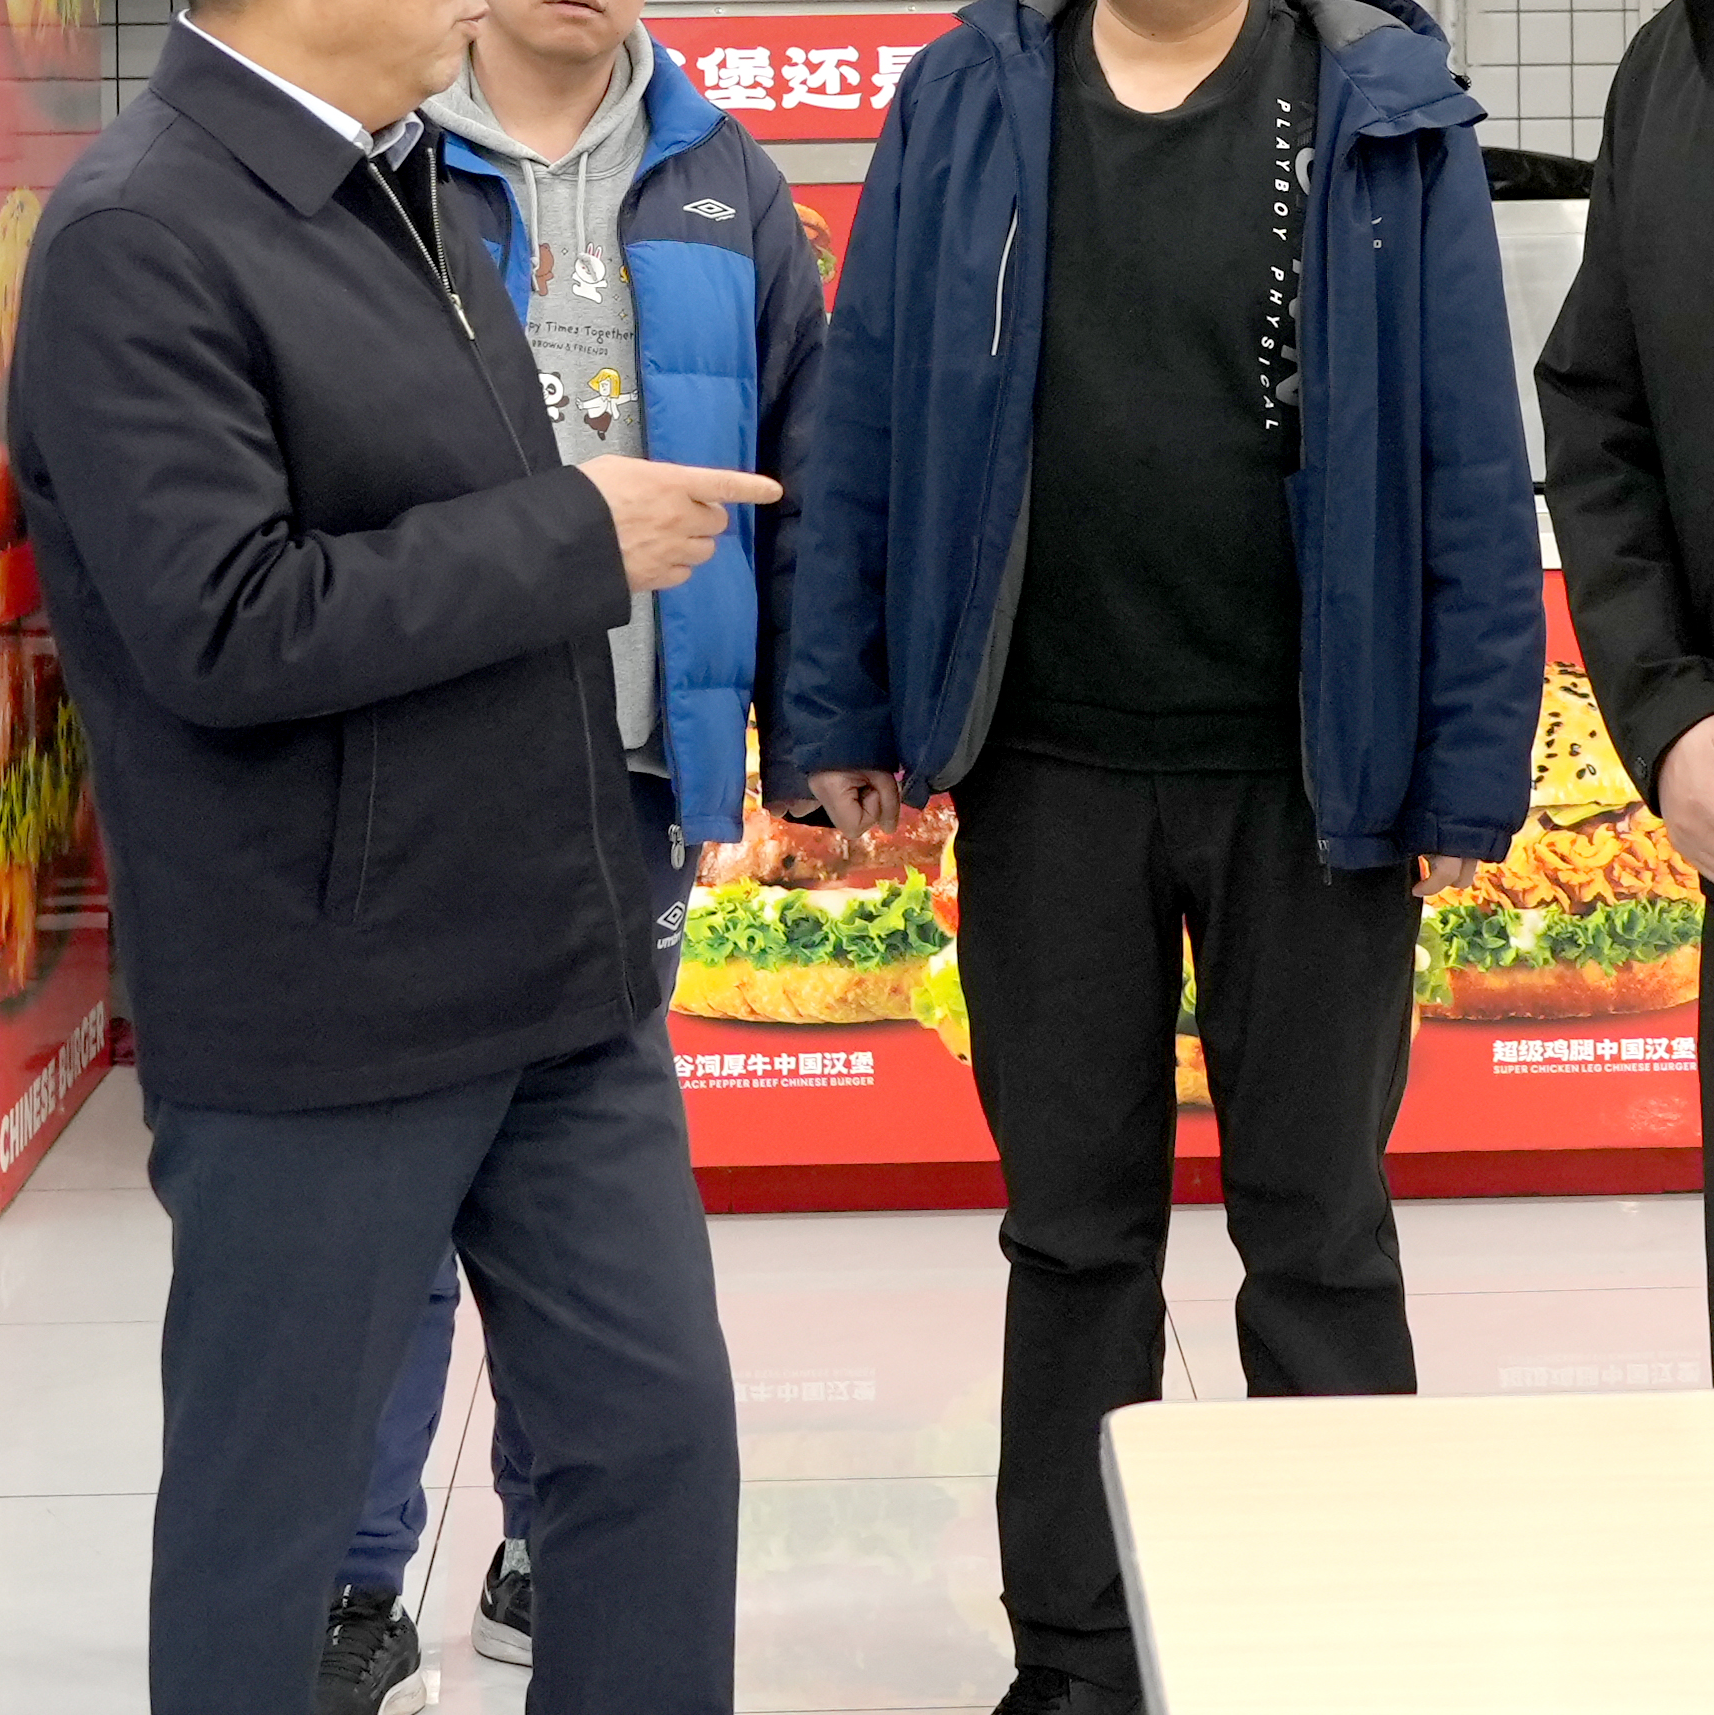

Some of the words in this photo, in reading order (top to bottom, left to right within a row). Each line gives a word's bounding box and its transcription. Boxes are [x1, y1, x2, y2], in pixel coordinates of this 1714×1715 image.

[668, 45, 928, 112] 堡还
[1273, 97, 1292, 242] PLAYBOY
[546, 321, 579, 335] Times
[1258, 265, 1285, 431] PHYSICAL
[1493, 1037, 1696, 1062] 超级鸡腿中国汉堡
[674, 1051, 874, 1078] 谷饲厚牛中国汉堡
[1493, 1064, 1528, 1074] SUPER
[1530, 1063, 1580, 1074] CHICKEN
[1581, 1063, 1602, 1073] LEG
[1604, 1062, 1651, 1073] CHINESE
[1653, 1061, 1698, 1072] BURGER
[0, 1057, 57, 1173] CHINESE
[58, 1000, 106, 1100] BURGER
[678, 1078, 707, 1090] LACK
[709, 1078, 749, 1089] PEPPER
[752, 1078, 779, 1088] BEEF
[781, 1077, 828, 1088] CHINESE
[830, 1076, 875, 1087] BURGER
